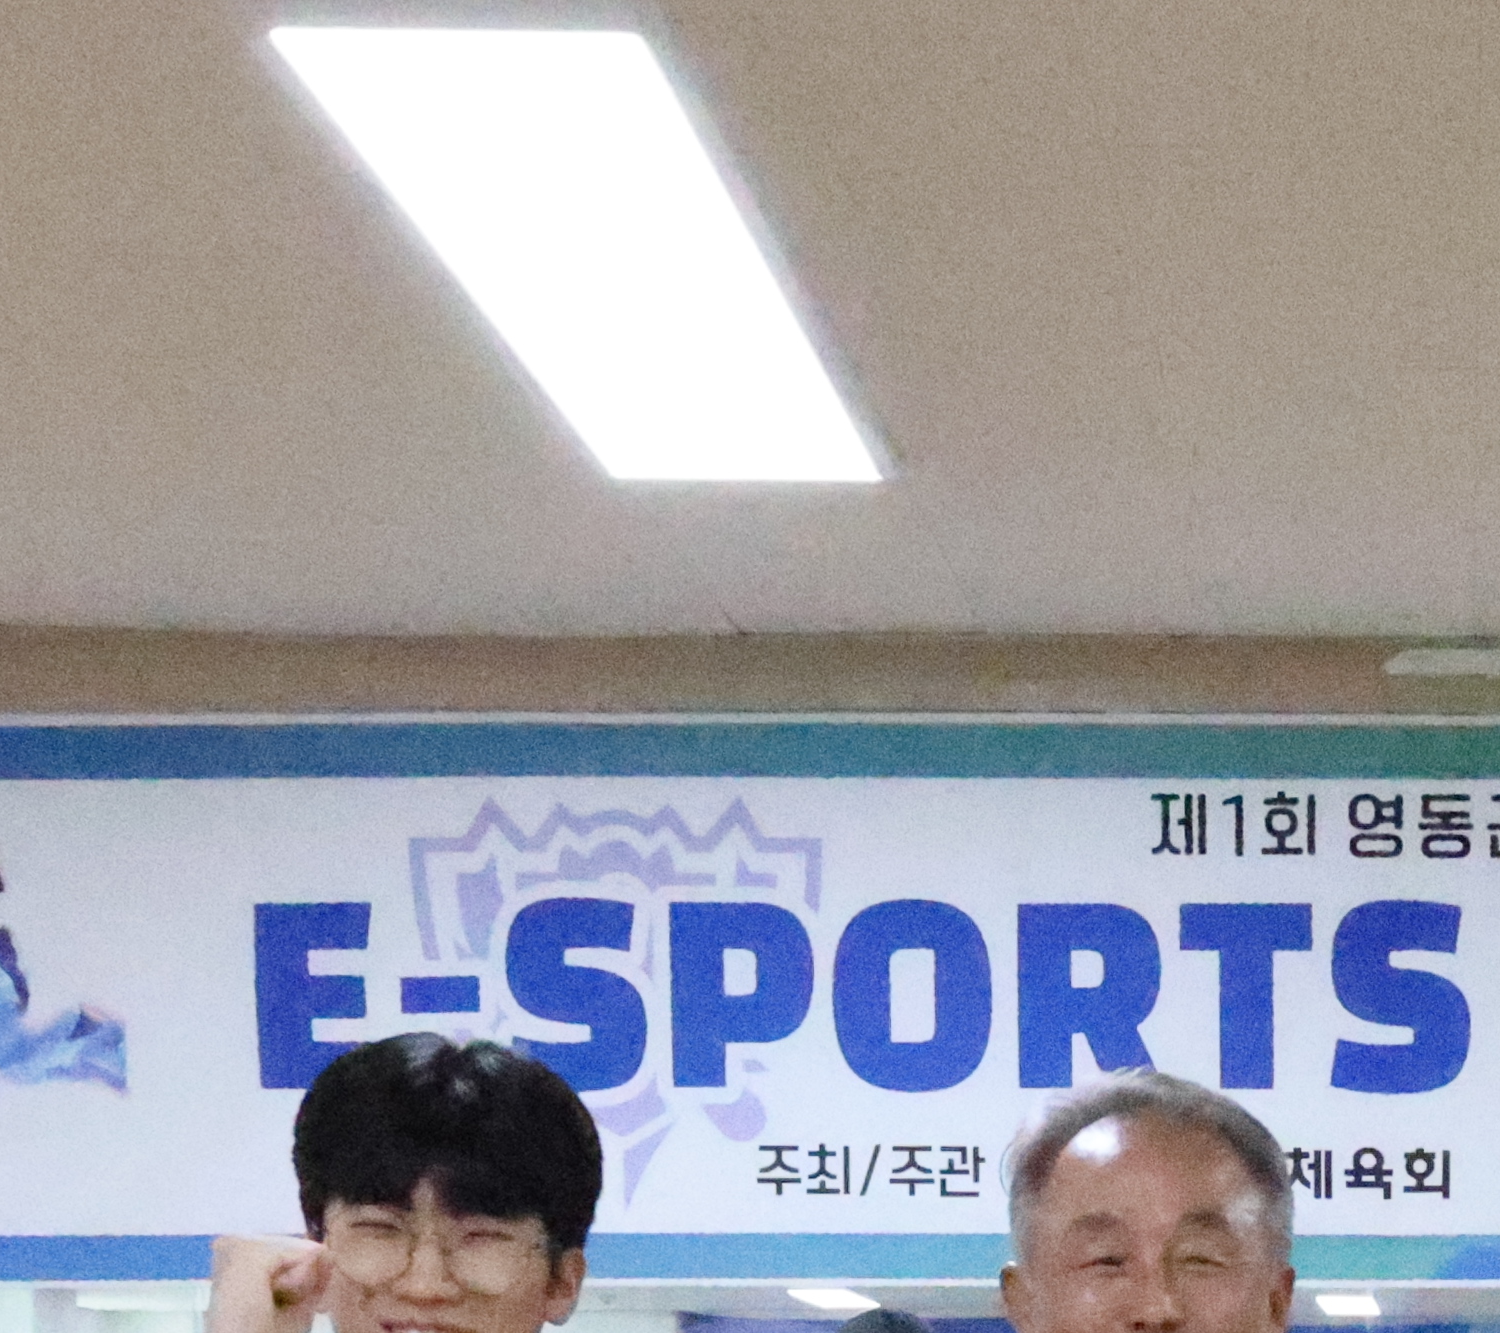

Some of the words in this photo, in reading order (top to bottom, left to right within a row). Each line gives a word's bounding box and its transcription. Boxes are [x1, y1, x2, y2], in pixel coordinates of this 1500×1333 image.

[1150, 791, 1317, 857] 제1회
[254, 898, 1472, 1093] E-SPORTS
[757, 1143, 986, 1198] 주최/주관
